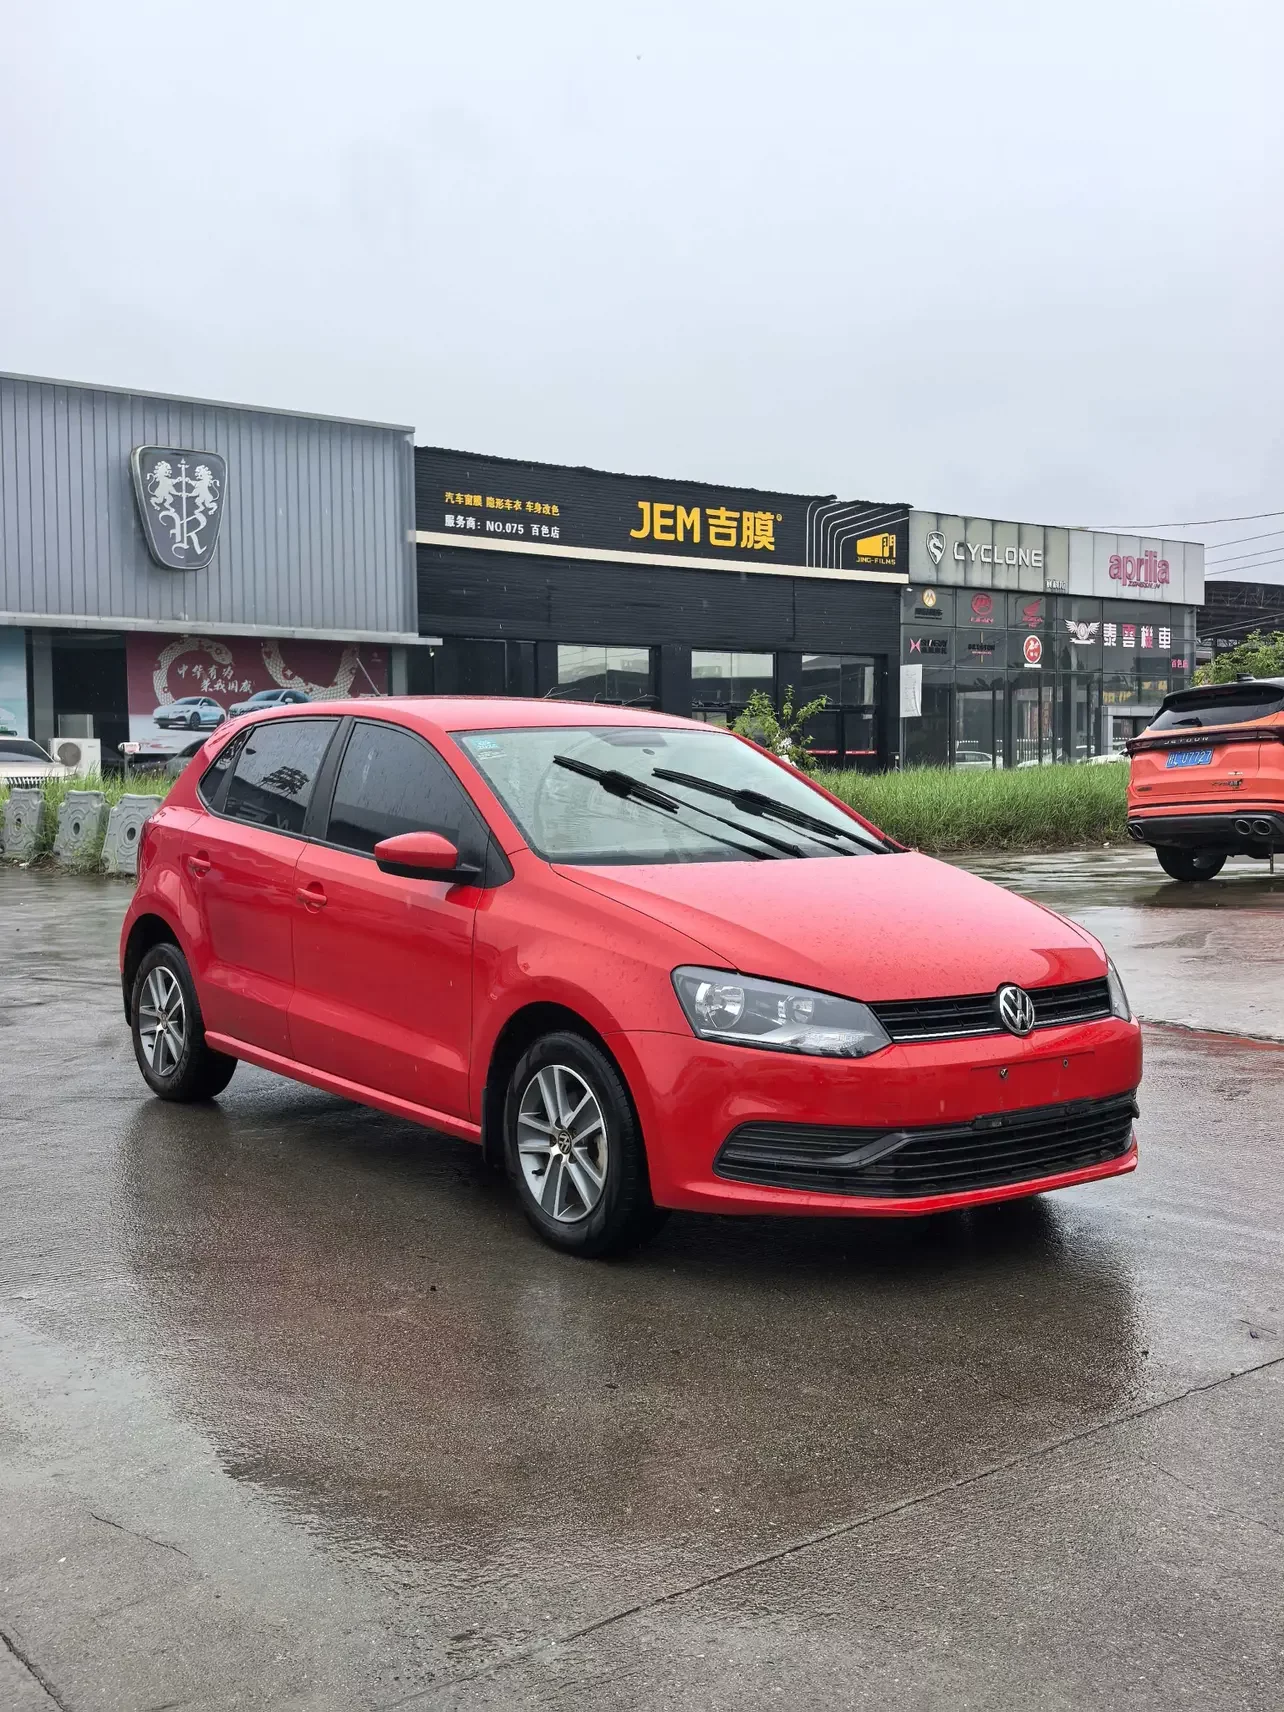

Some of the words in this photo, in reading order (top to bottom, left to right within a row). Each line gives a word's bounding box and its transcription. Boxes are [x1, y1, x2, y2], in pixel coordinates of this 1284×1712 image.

[485, 496, 522, 511] 隐形车衣
[525, 501, 560, 516] 车身改色
[486, 520, 524, 534] NO.075
[530, 523, 560, 539] 百色店
[630, 501, 701, 543] JEM
[705, 506, 776, 551] 吉膜
[953, 541, 1043, 568] CYCLONE
[1108, 550, 1170, 587] aprilia
[177, 664, 234, 680] 中华有为
